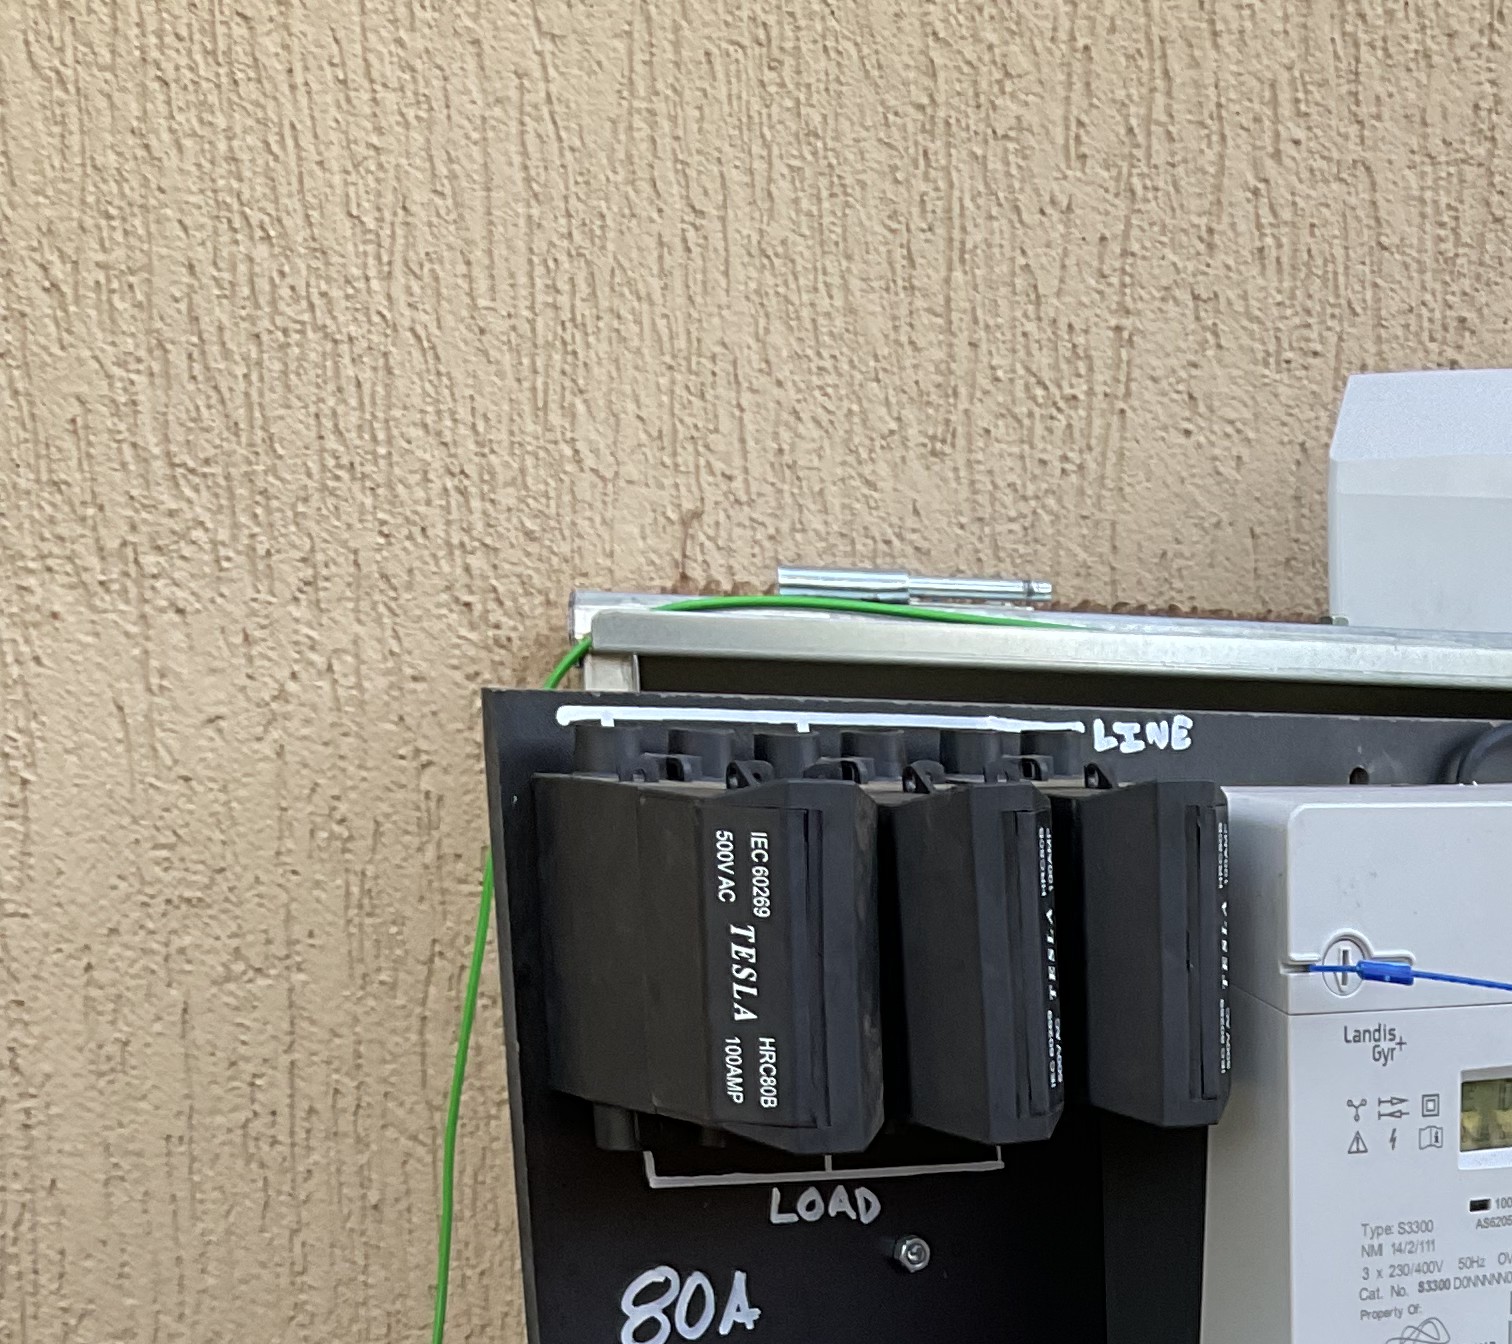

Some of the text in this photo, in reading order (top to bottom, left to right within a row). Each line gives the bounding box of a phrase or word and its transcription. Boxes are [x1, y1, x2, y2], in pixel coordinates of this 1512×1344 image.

[1093, 714, 1194, 754] LINE
[716, 830, 736, 902] 500V AC
[750, 831, 771, 918] IEC 60269
[730, 924, 758, 1021] TESLA
[1046, 909, 1057, 1000] TESLA
[1344, 1023, 1397, 1044] Landis
[1372, 1044, 1397, 1067] Gyr
[724, 1036, 744, 1104] 100AMP
[758, 1037, 778, 1108] HRC80B
[769, 1184, 882, 1225] LOAD
[1397, 1219, 1434, 1235] S3300
[1362, 1266, 1370, 1280] 3
[1458, 1256, 1486, 1270] 50Hz
